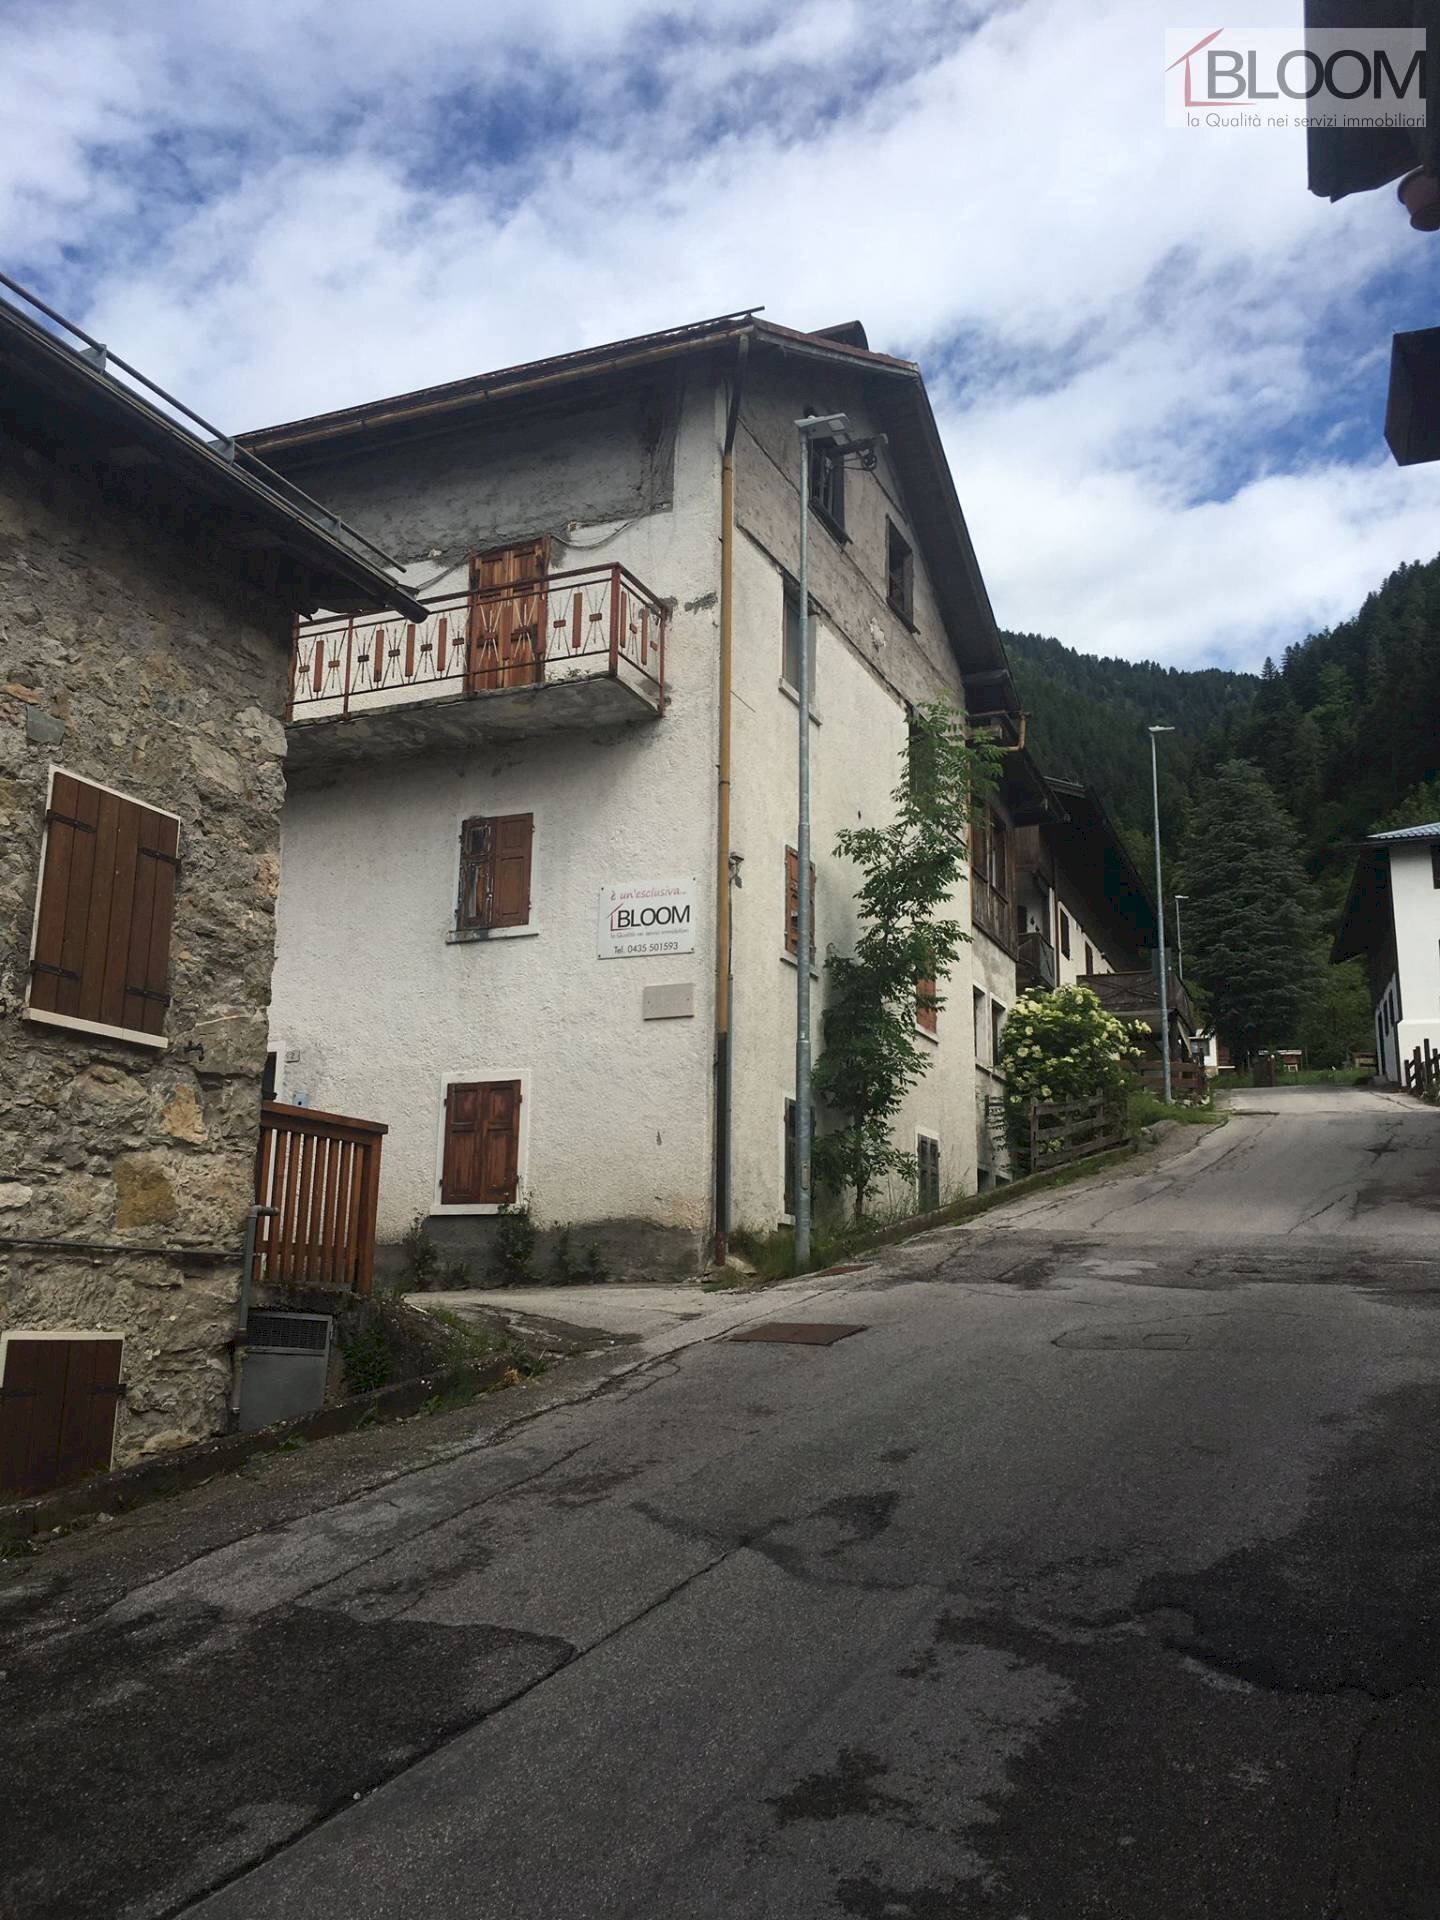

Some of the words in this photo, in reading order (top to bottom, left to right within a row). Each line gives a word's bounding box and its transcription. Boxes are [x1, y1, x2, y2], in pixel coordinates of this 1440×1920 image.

[617, 905, 690, 928] BLOOM
[627, 944, 647, 953] 0435
[649, 942, 679, 951] 501593
